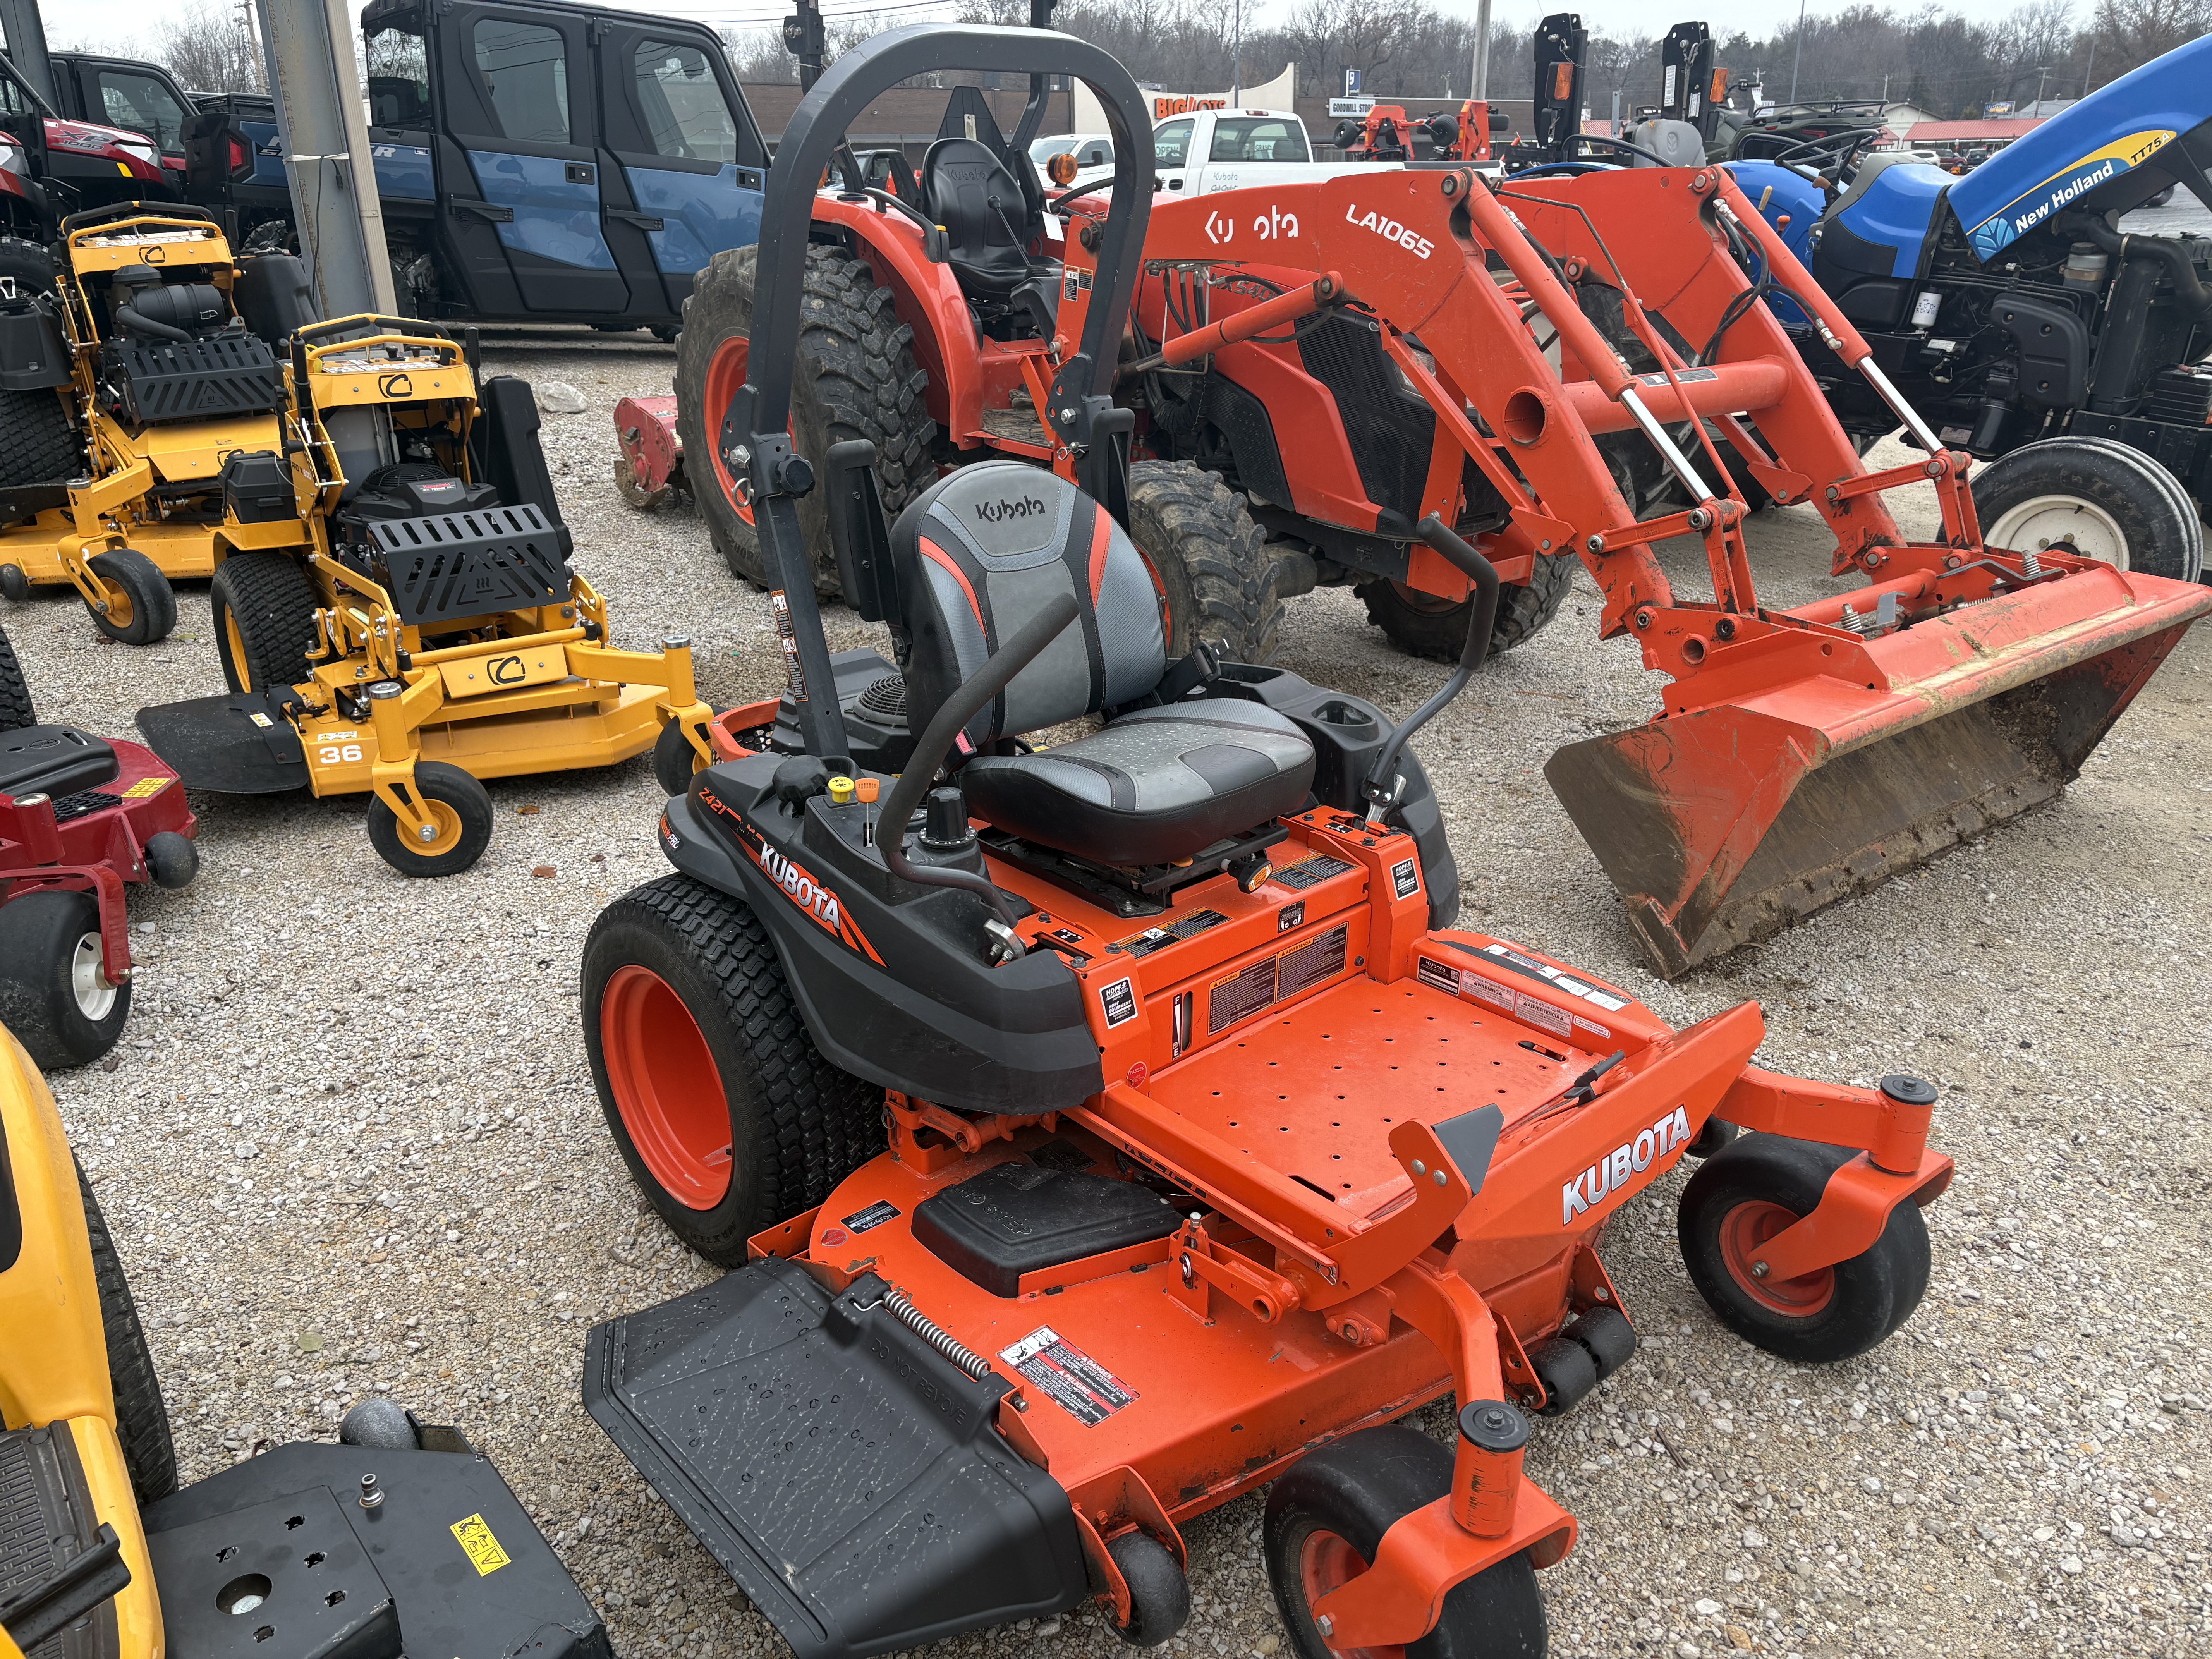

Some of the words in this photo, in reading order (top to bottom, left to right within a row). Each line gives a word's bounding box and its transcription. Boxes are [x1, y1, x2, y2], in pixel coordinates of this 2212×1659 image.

[1333, 103, 1357, 112] GOODWILL
[64, 139, 104, 150] 1000
[2130, 132, 2171, 163] TT75A
[948, 168, 986, 180] Kubota
[2015, 202, 2049, 234] New
[2052, 160, 2114, 209] Holland
[1346, 204, 1435, 259] LA1065
[975, 495, 1046, 523] Kubota
[319, 745, 362, 764] 36
[699, 787, 728, 815] Z421
[1395, 863, 1408, 872] HOPF
[759, 841, 841, 930] KUBOTA
[1286, 939, 1311, 954] ADVERTENCIA
[1426, 959, 1446, 972] Kubota
[1219, 973, 1237, 985] WARNING
[1484, 980, 1506, 992] Proposition
[1105, 984, 1122, 996] HOPF
[1477, 982, 1499, 994] WARNING
[1108, 1001, 1120, 1009] HOPF
[1108, 1000, 1132, 1013] EQUIPMENT
[1175, 996, 1180, 1005] F
[1518, 994, 1538, 1005] Propuesta
[1551, 1007, 1570, 1018] California
[1527, 1003, 1559, 1019] ADVERTENCIA
[1174, 1048, 1179, 1056] E
[1129, 1066, 1145, 1075] PASSED
[1563, 1105, 1691, 1226] KUBOTA
[861, 1213, 892, 1230] Kubota
[983, 1204, 1032, 1235] STEP
[1051, 1348, 1065, 1357] ENGINE
[1024, 1363, 1040, 1375] MIENTRAS
[1030, 1359, 1048, 1372] DESCARGA
[1065, 1349, 1077, 1358] CLEAR
[1079, 1360, 1099, 1374] DISCHARGE
[1096, 1373, 1113, 1385] OPENING
[1085, 1359, 1114, 1380] DANGER
[871, 1338, 889, 1359] DO
[895, 1355, 918, 1382] NOT
[916, 1377, 967, 1426] REMOVE
[1017, 1367, 1036, 1381] DEFLECTOR
[1059, 1358, 1075, 1370] OPERATE
[1072, 1368, 1087, 1379] MOWER
[1084, 1377, 1101, 1389] WITHOUT
[1098, 1388, 1118, 1403] DISCHARGE
[1072, 1359, 1084, 1368] HANDS
[1102, 1382, 1116, 1392] MOWER
[1114, 1391, 1126, 1400] WHEN
[1032, 1374, 1050, 1388] FUNCIONAR
[1051, 1389, 1071, 1403] CORTADORA
[1032, 1365, 1047, 1376] COLOQUE
[1050, 1379, 1062, 1388] MANOS
[1083, 1404, 1103, 1419] CORTADORA
[1052, 1371, 1066, 1381] ALEJADO
[1072, 1386, 1089, 1399] ABERTURA
[1063, 1373, 1092, 1395] PELIGRO
